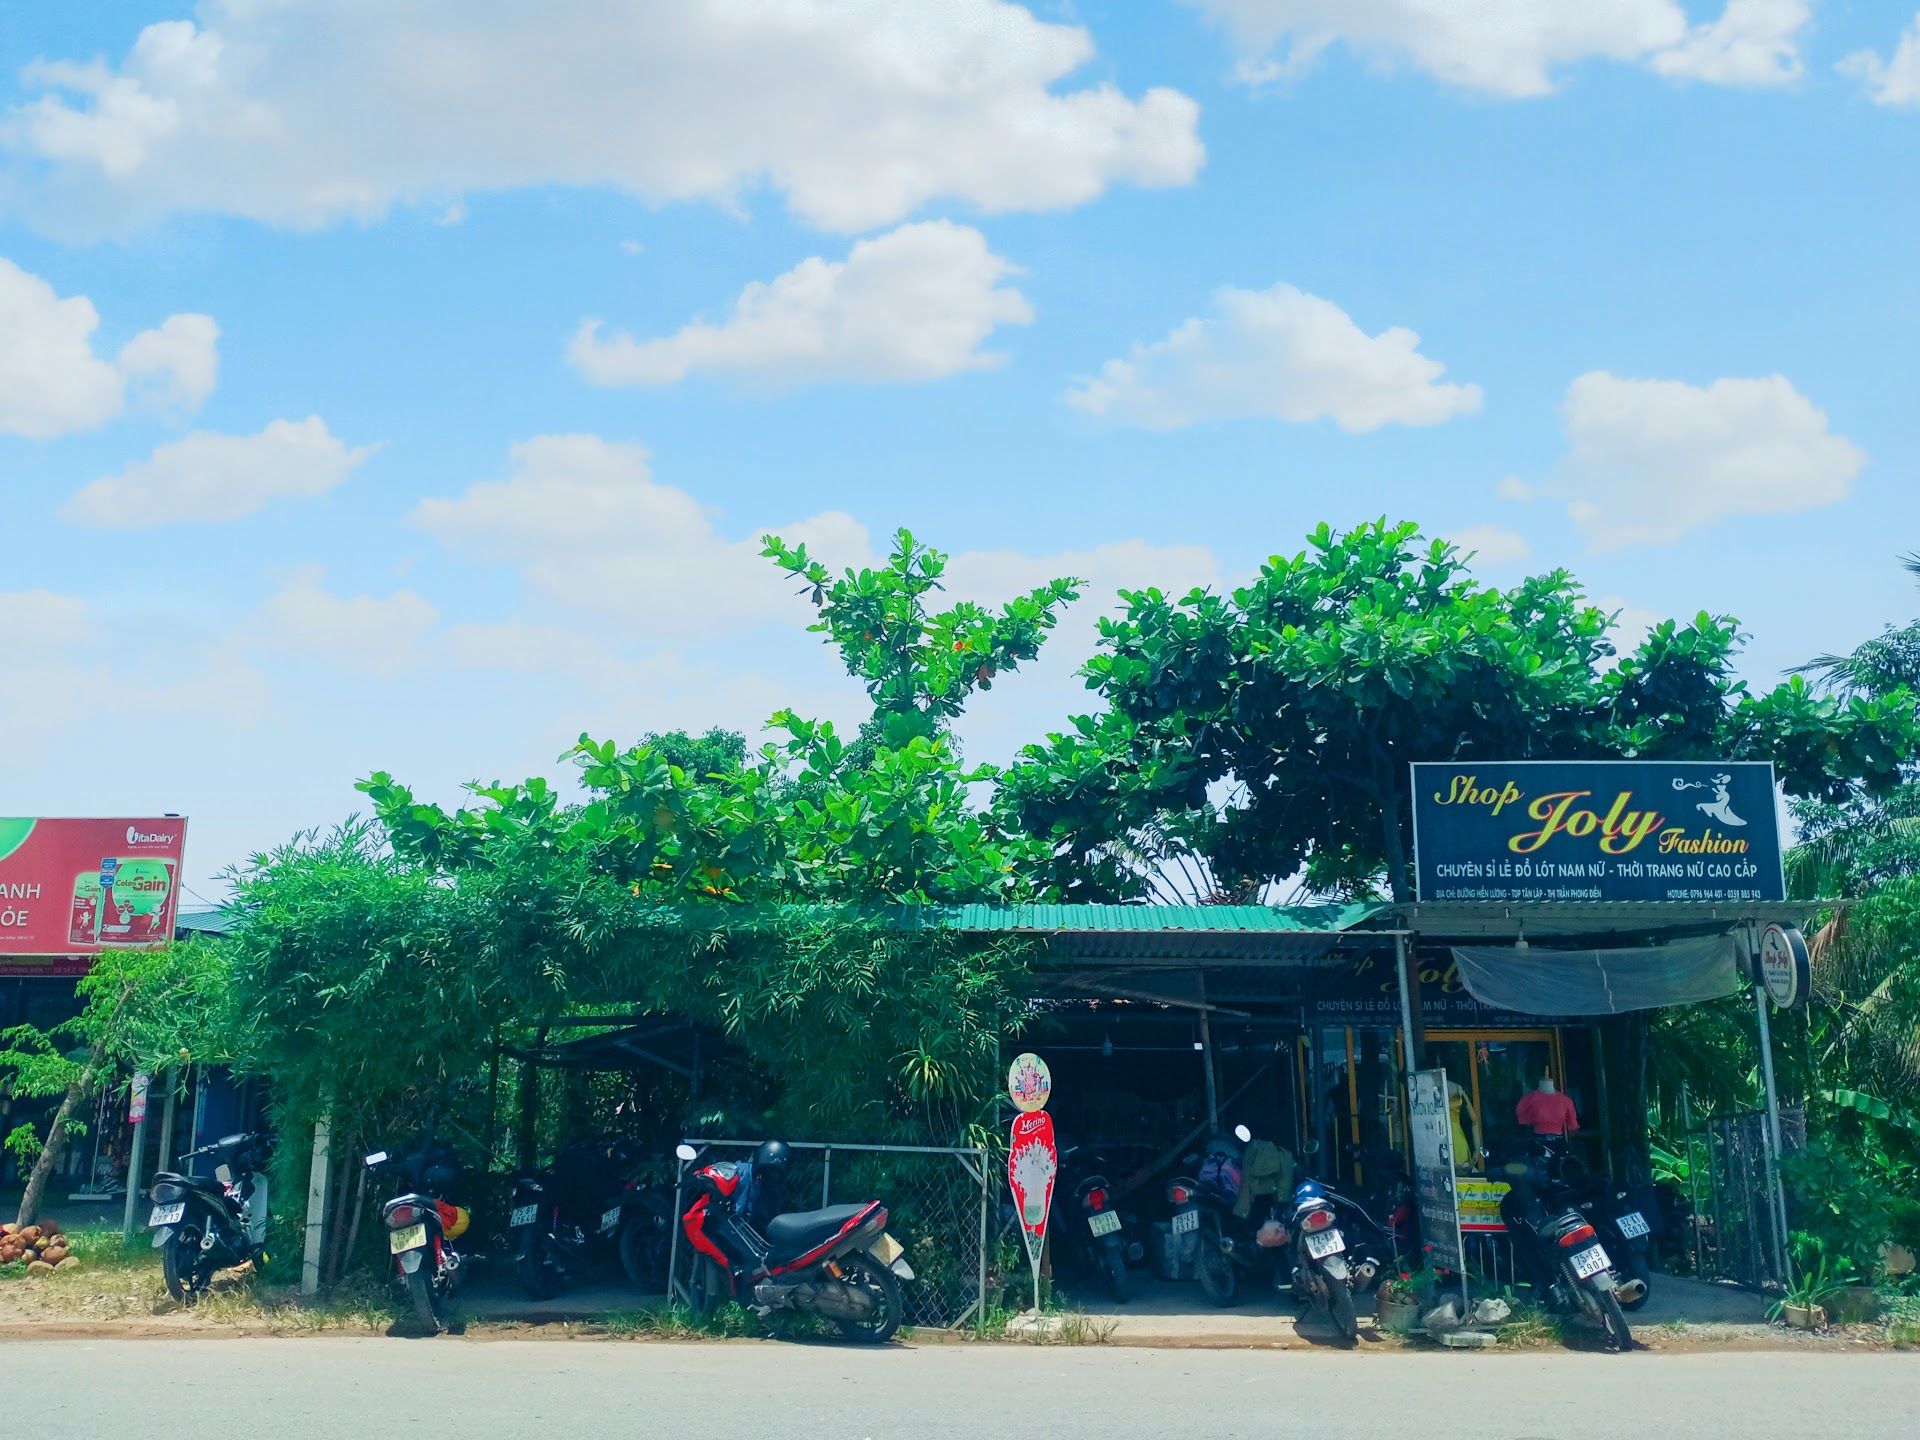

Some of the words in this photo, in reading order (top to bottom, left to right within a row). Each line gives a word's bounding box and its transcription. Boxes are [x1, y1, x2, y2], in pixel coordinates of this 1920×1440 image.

[1434, 775, 1525, 816] Shop
[1508, 789, 1665, 854] Joly
[1658, 828, 1749, 854] Fashion
[1436, 860, 1482, 877] CHUYÊN
[1499, 859, 1512, 877] LẺ
[1515, 858, 1532, 877] ĐỒ
[1535, 860, 1555, 877] LÓT
[1558, 863, 1585, 877] NAM
[1588, 861, 1605, 877] NỮ
[1617, 860, 1643, 877] THỜI
[1646, 863, 1684, 877] TRANG
[1687, 861, 1704, 877] NỮ
[1707, 863, 1731, 877] CAO
[1734, 858, 1757, 877] CẤP
[1570, 889, 1588, 898] PHONG
[1317, 999, 1353, 1011] CHUYÊN
[1021, 1116, 1046, 1131] Merino
[1580, 1257, 1605, 1275] 3907
